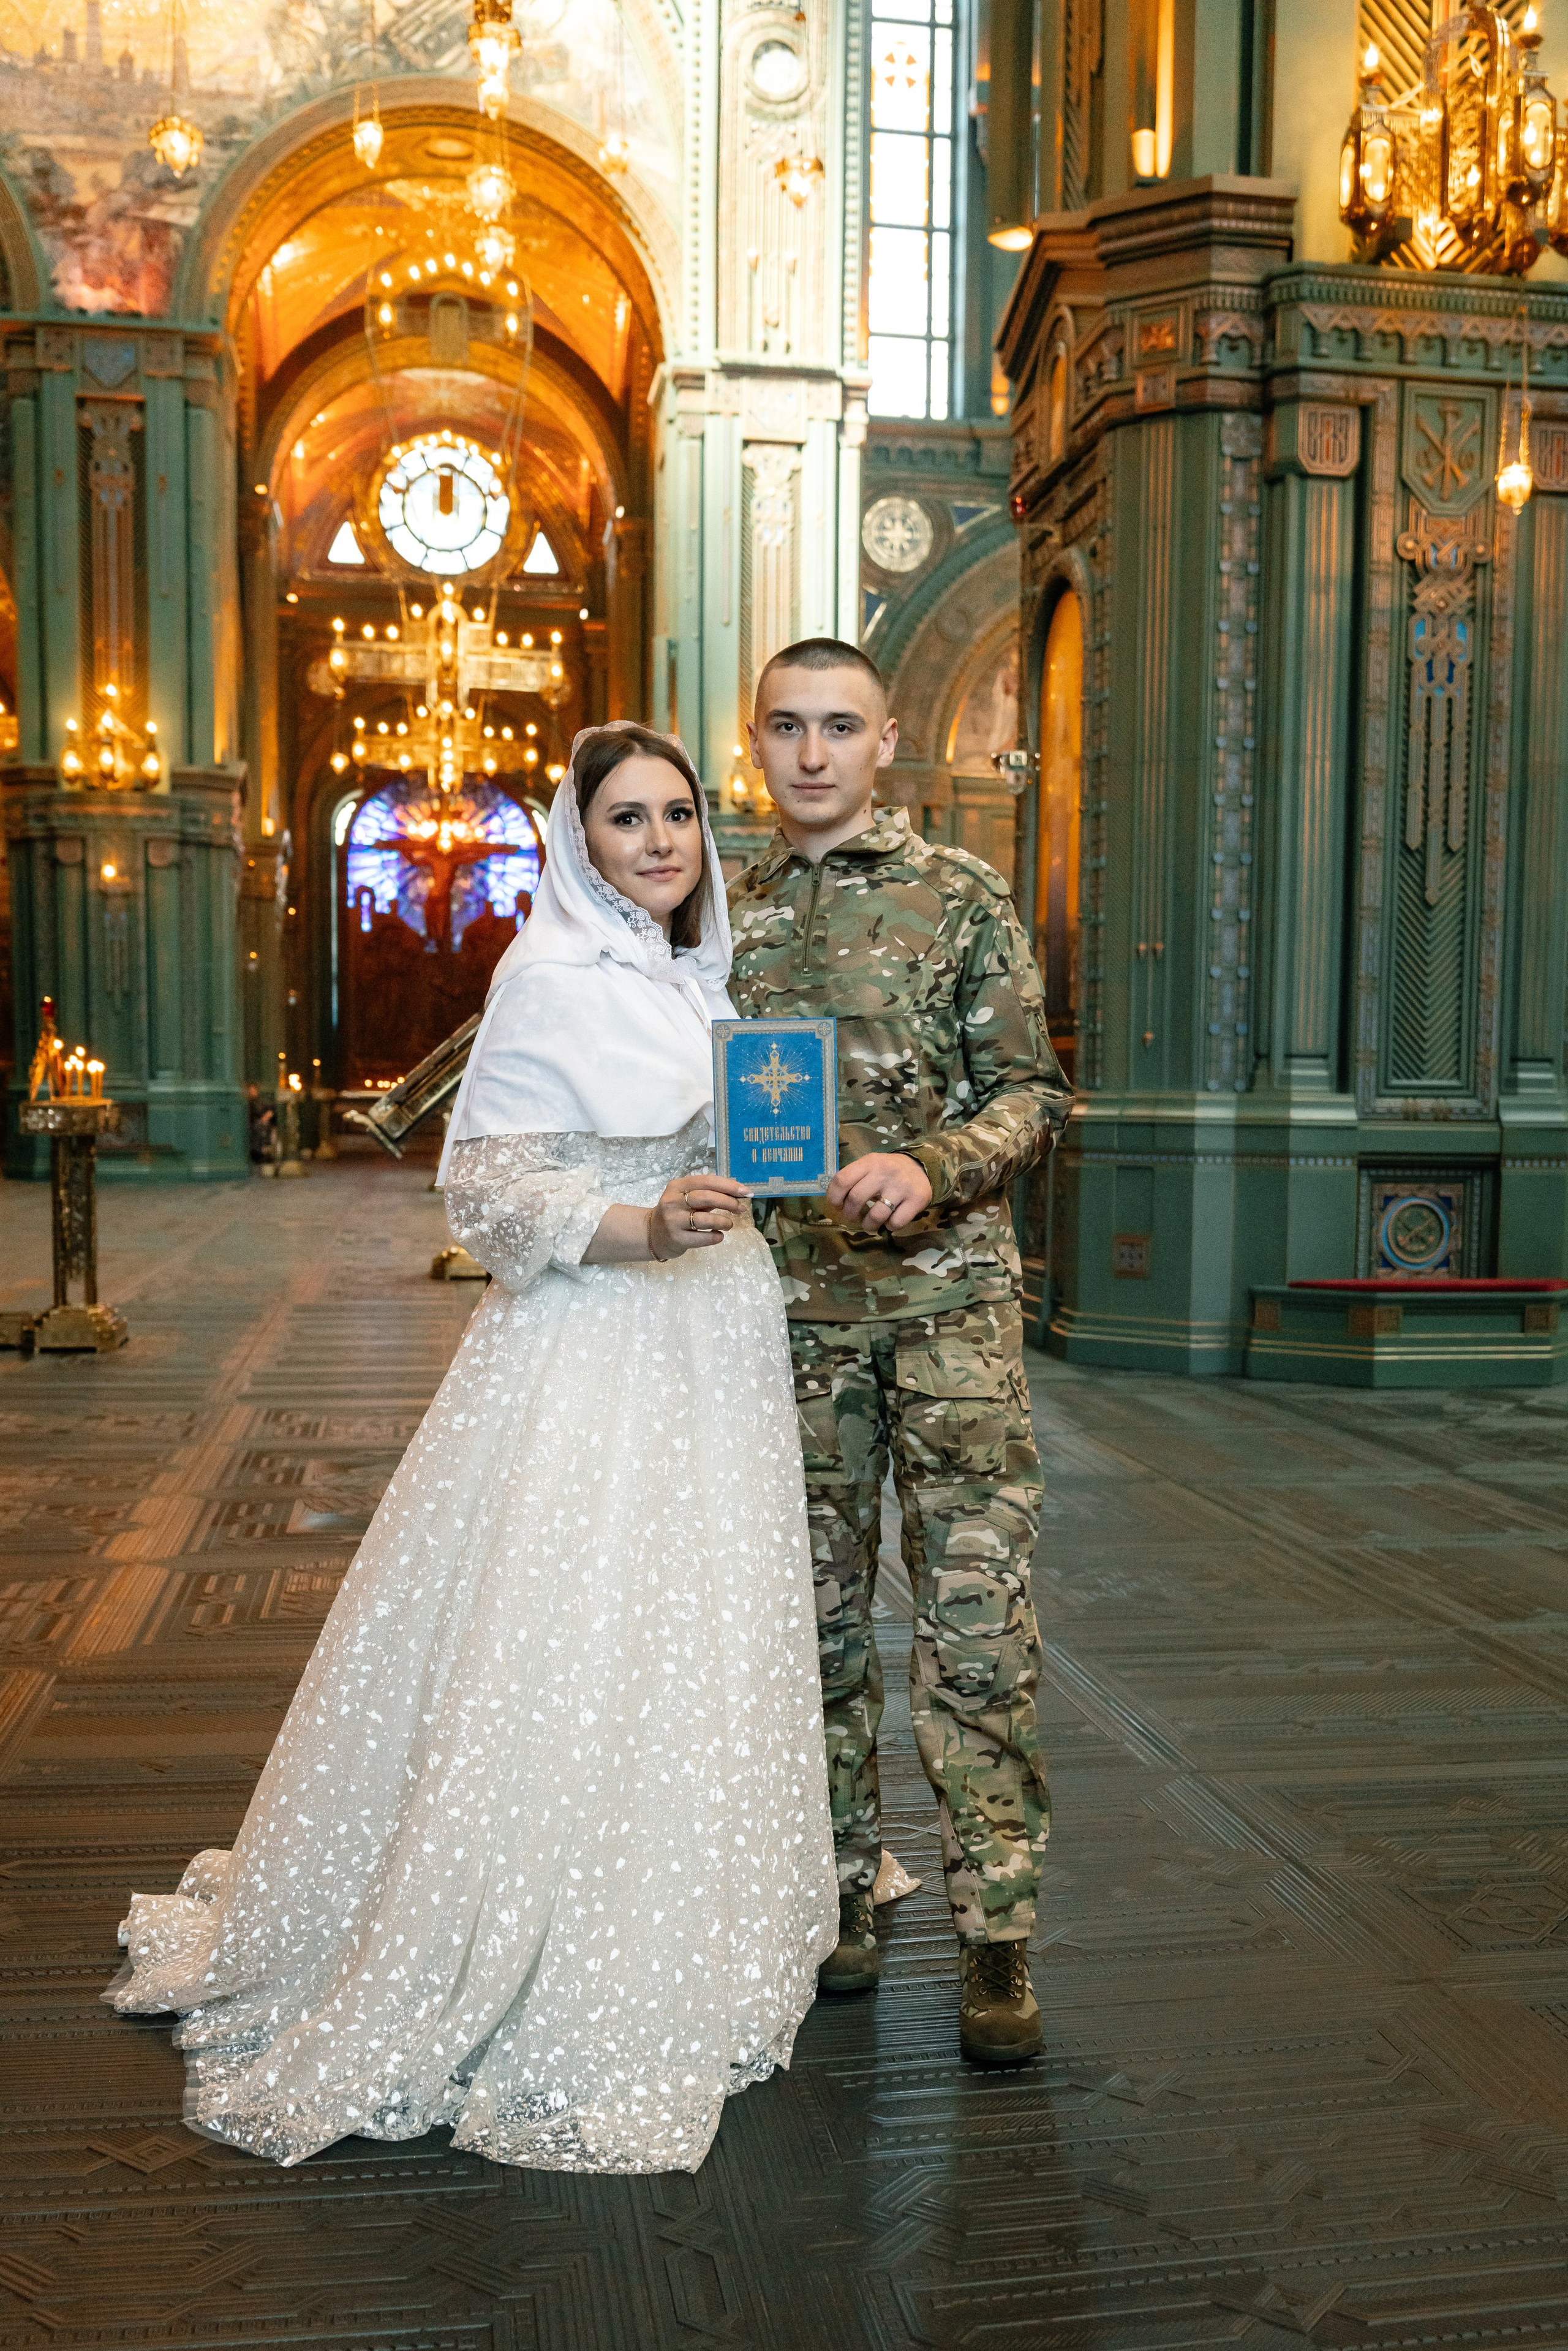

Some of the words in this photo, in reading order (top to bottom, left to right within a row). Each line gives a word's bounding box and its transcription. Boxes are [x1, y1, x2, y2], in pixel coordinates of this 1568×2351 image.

[744, 1125, 810, 1144] СВИДЕТЕЛЬСТВО
[752, 1149, 757, 1163] О
[763, 1147, 803, 1163] ВЕНЧАНИИ
